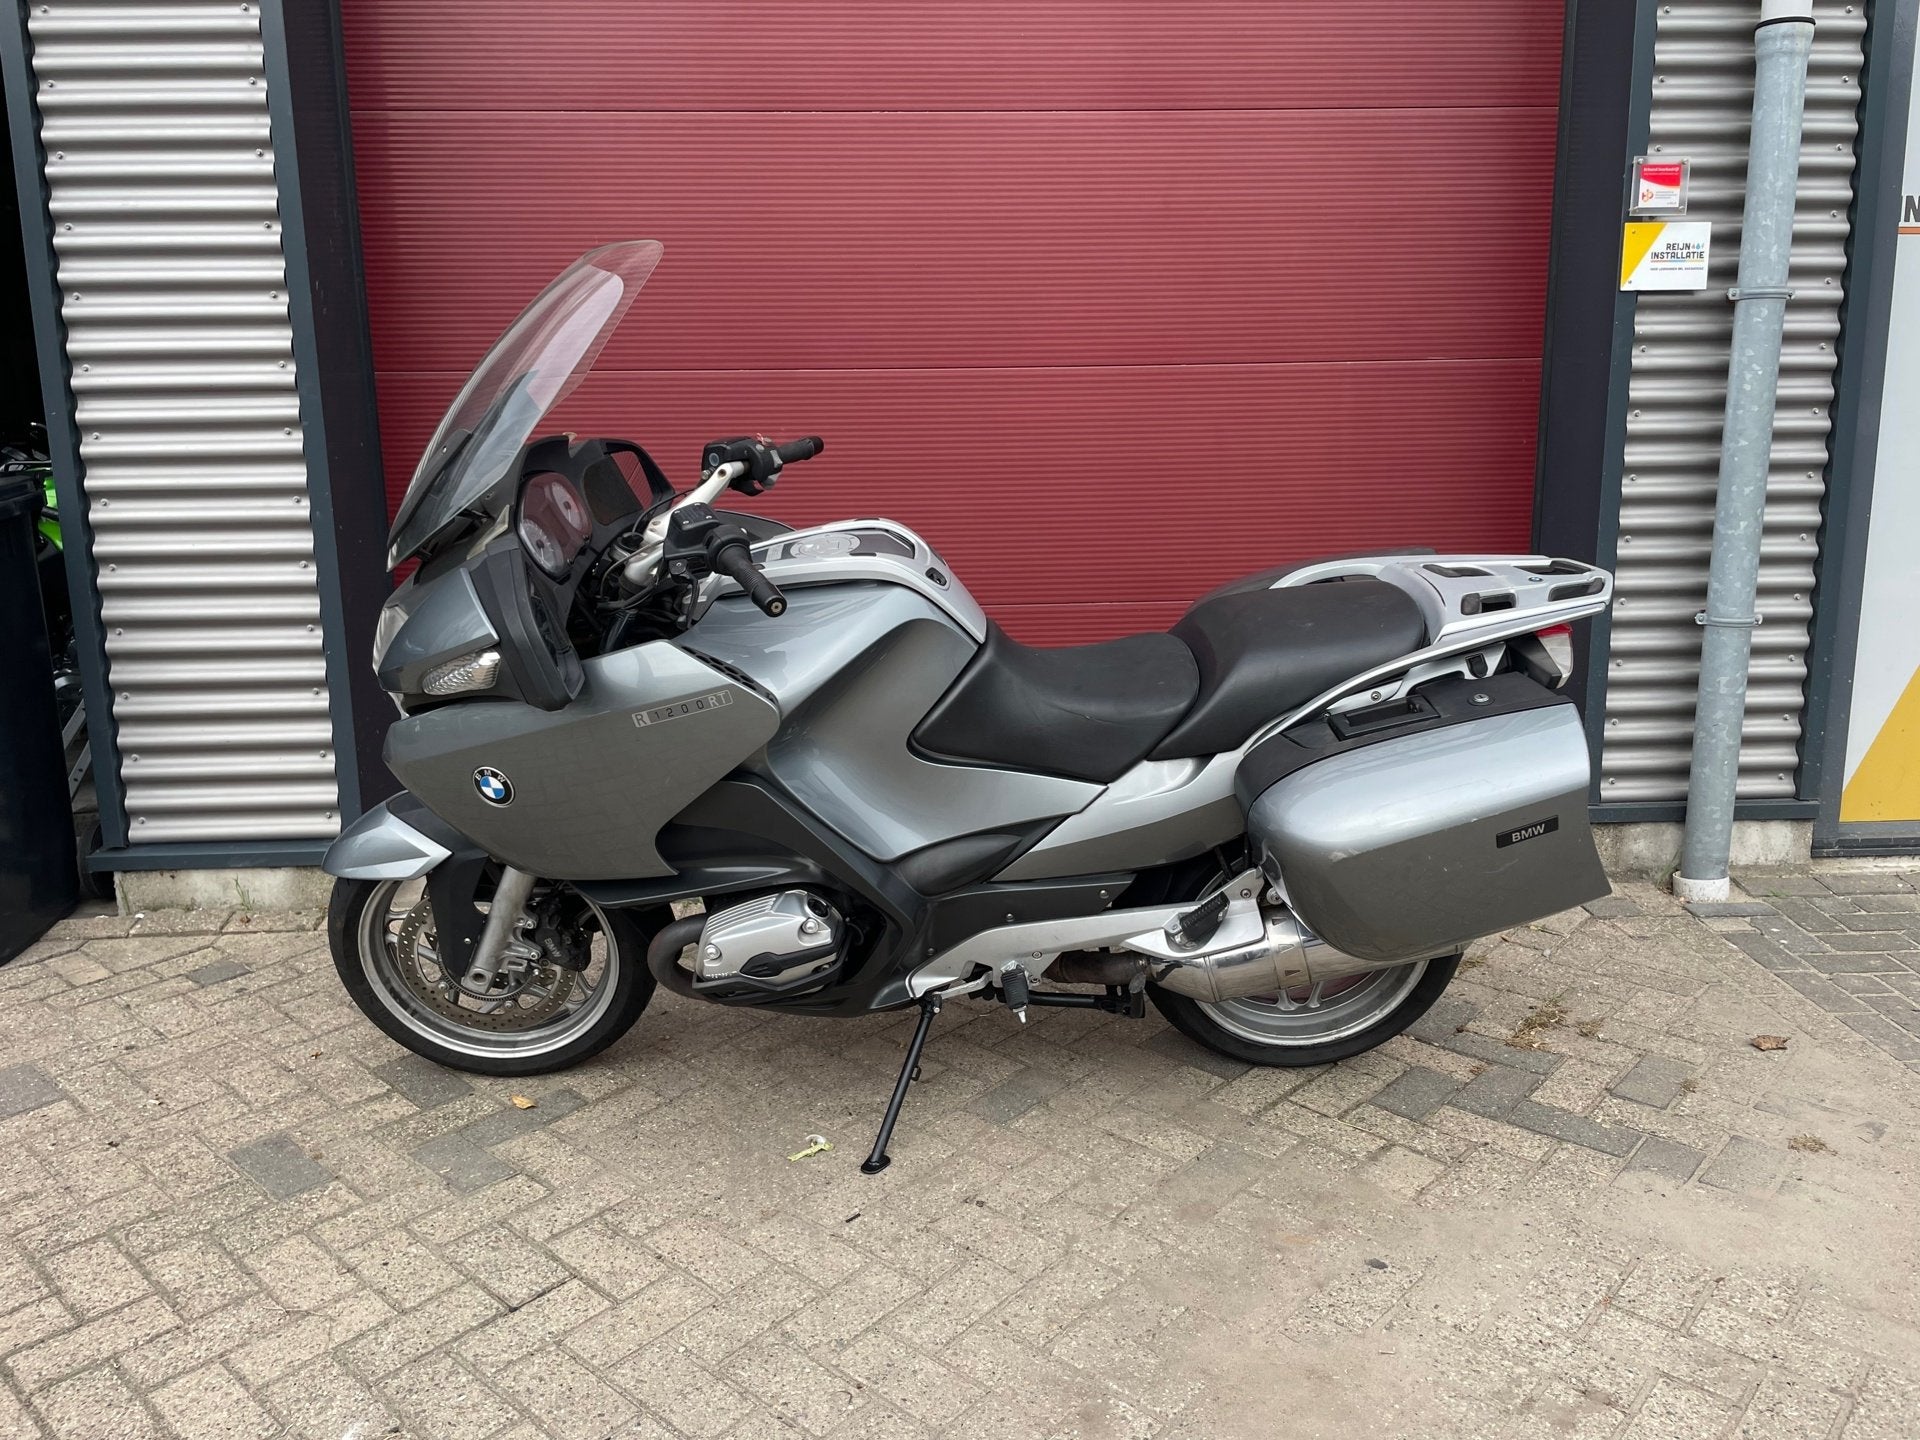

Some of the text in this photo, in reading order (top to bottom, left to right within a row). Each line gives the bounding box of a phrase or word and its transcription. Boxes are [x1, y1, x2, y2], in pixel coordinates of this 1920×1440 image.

[1666, 242, 1691, 251] REIJN
[1650, 251, 1705, 260] INSTALLATIE
[475, 769, 506, 783] BMW
[1512, 823, 1545, 842] BMW
